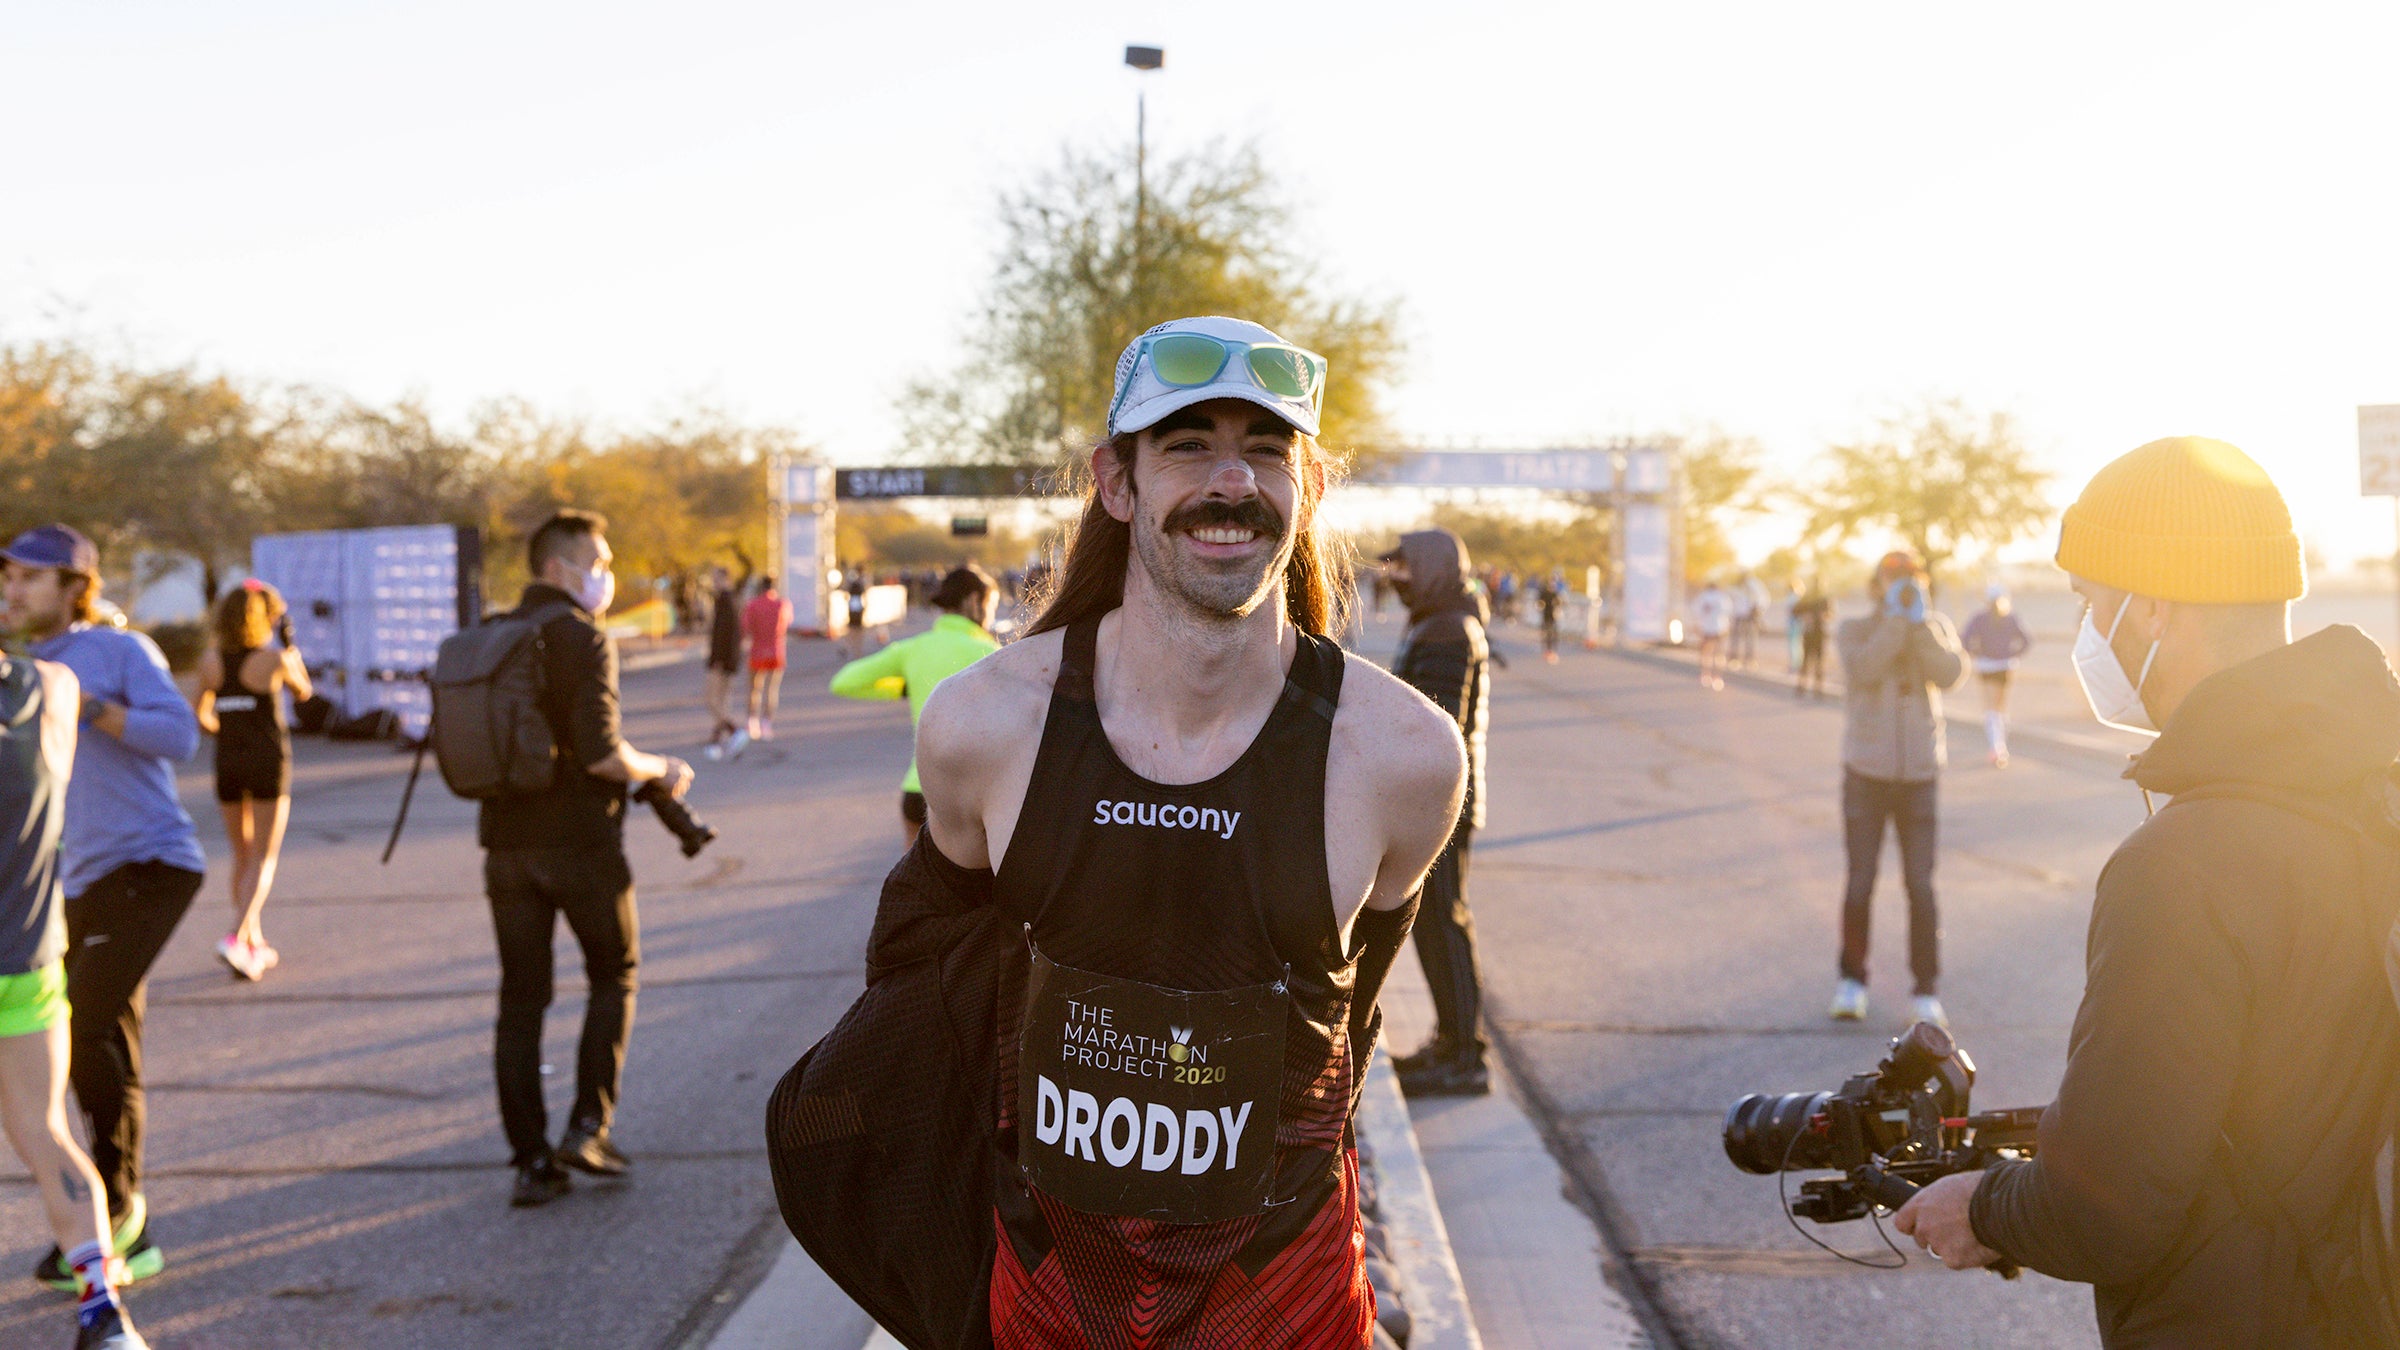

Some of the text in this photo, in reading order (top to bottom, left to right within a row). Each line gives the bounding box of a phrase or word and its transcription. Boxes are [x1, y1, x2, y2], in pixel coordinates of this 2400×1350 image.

[848, 470, 925, 496] START
[1093, 798, 1241, 840] saucony
[1067, 1000, 1114, 1027] THE
[1064, 1022, 1207, 1064] MARATHON
[1063, 1045, 1226, 1085] PROJECT 2020
[1036, 1073, 1253, 1176] DRODDY
